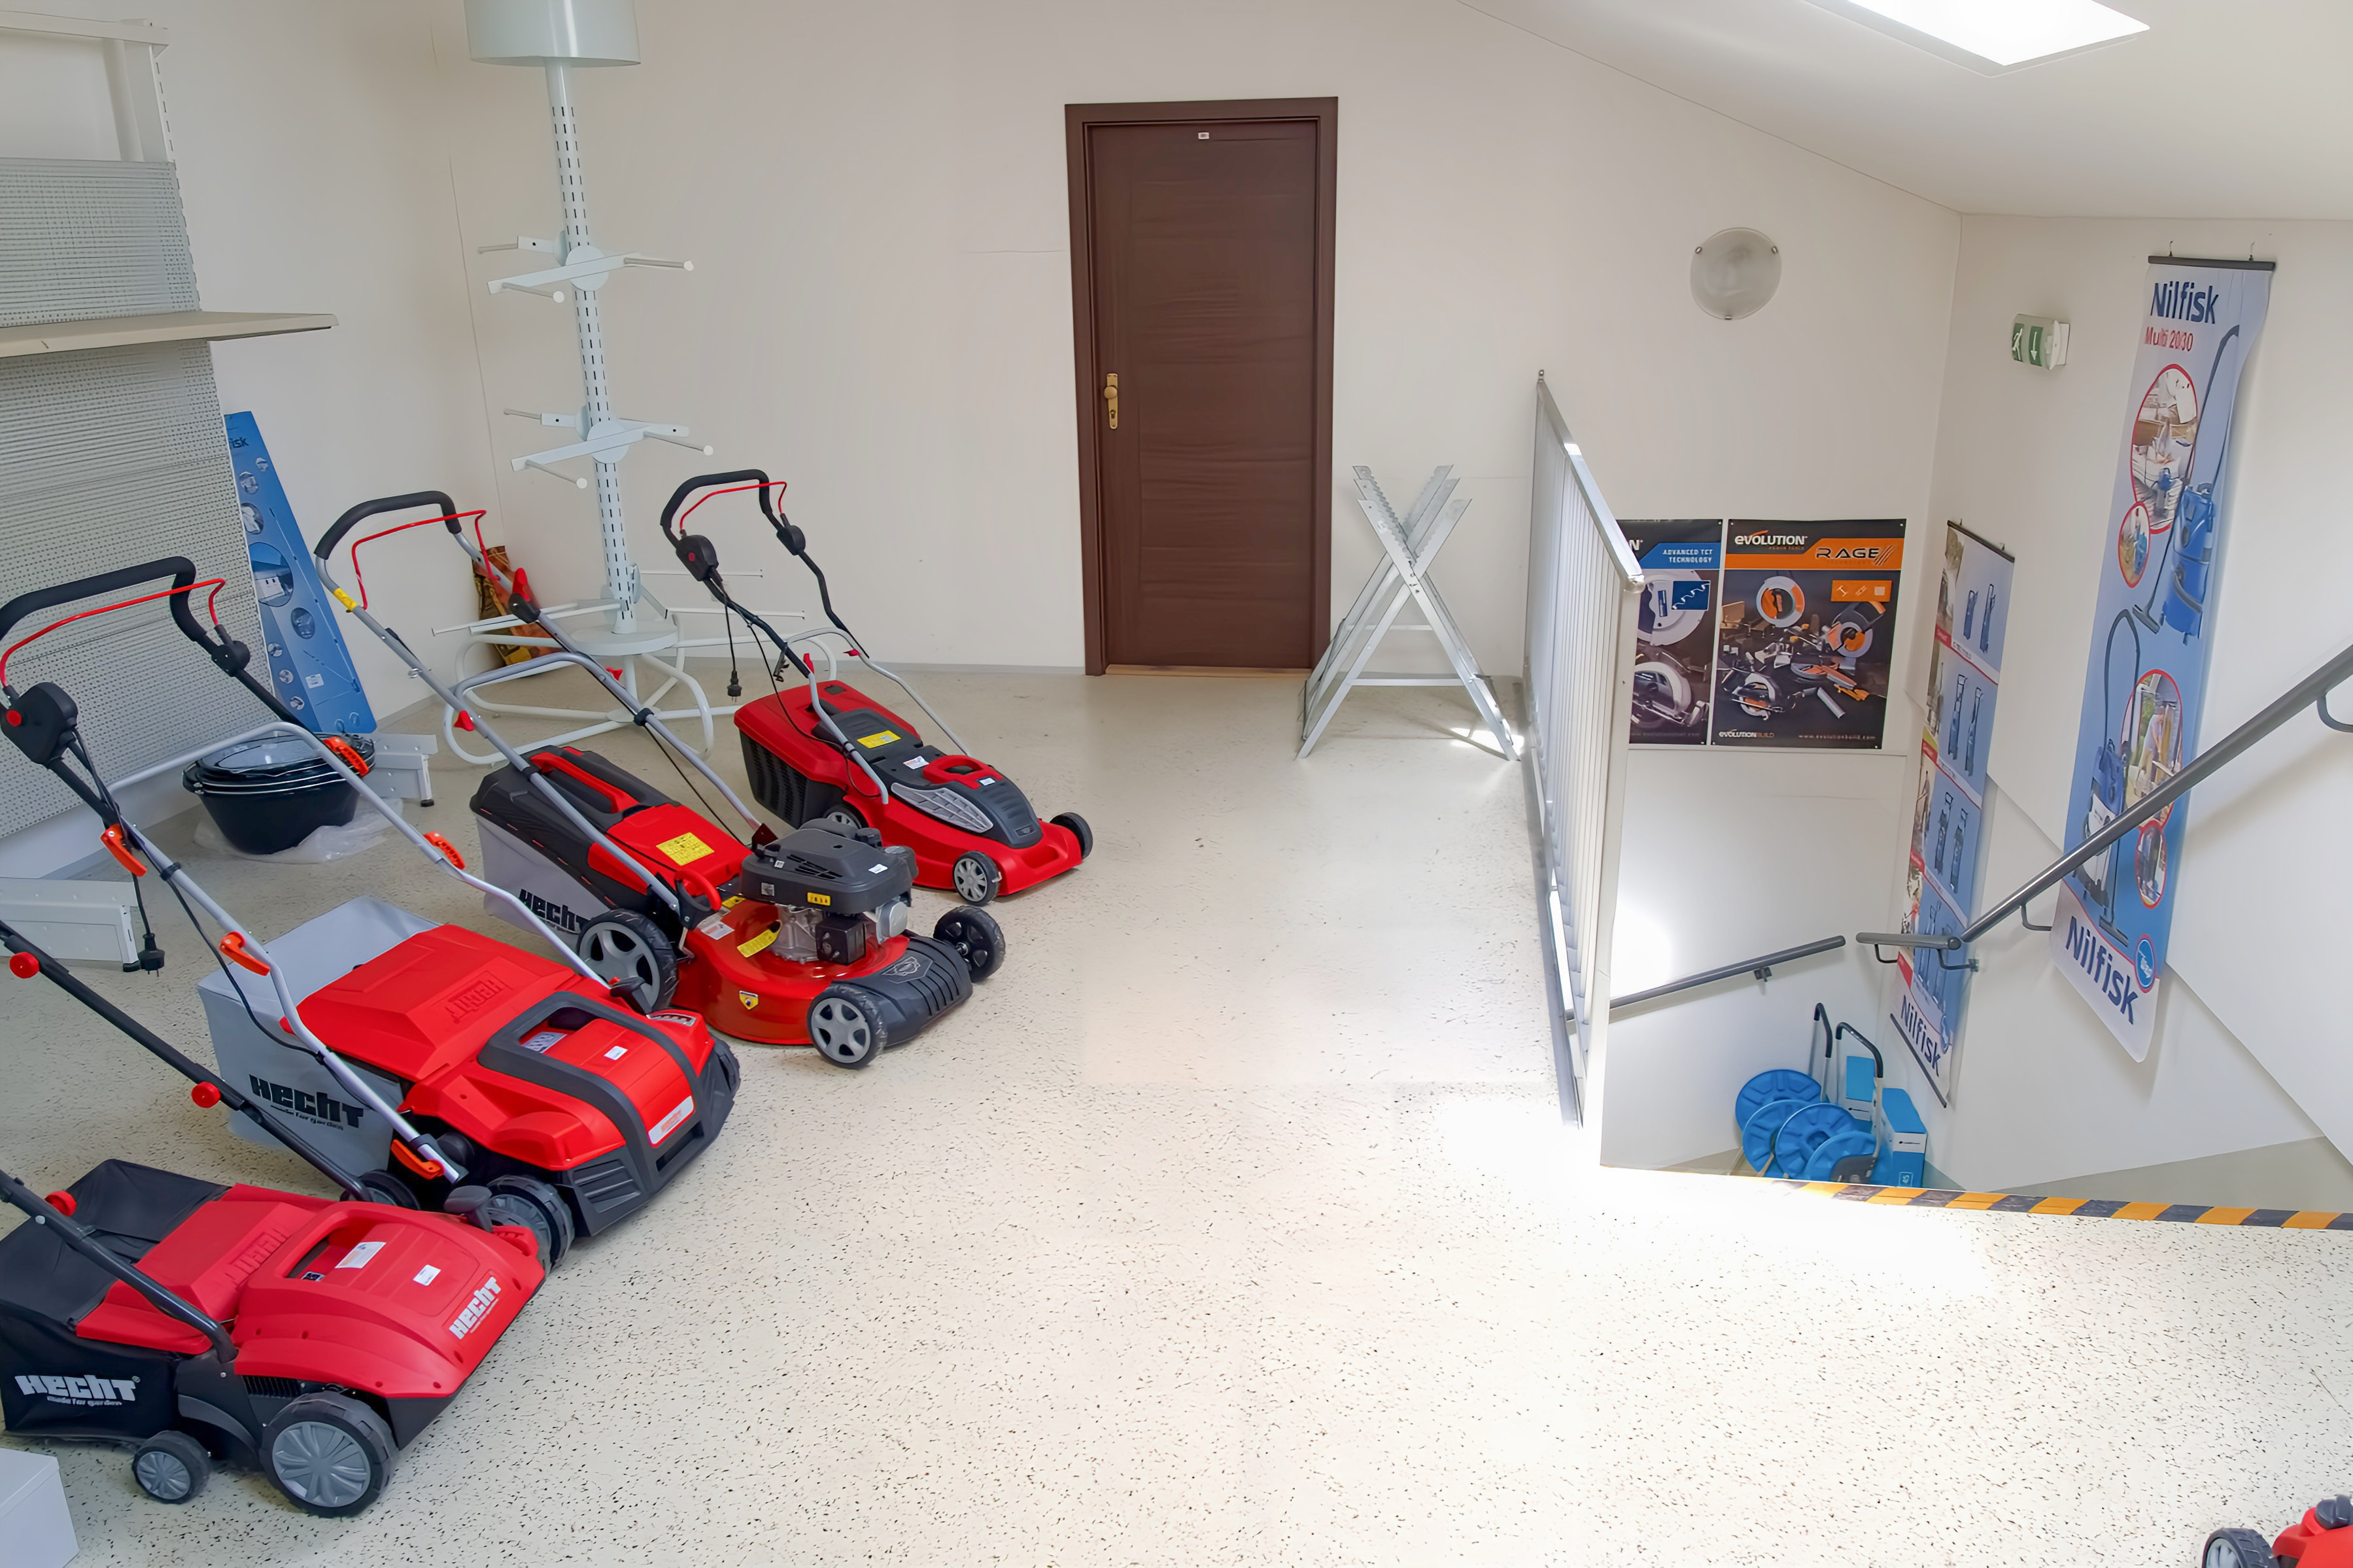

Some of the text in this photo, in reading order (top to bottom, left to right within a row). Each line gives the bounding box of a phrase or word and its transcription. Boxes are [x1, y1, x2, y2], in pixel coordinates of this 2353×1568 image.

[2150, 281, 2220, 324] Nilfisk
[2169, 330, 2193, 352] 2030
[1815, 547, 1880, 558] RAGE
[2065, 915, 2138, 1025] Nilfisk
[1900, 995, 1942, 1078] Nilfisk
